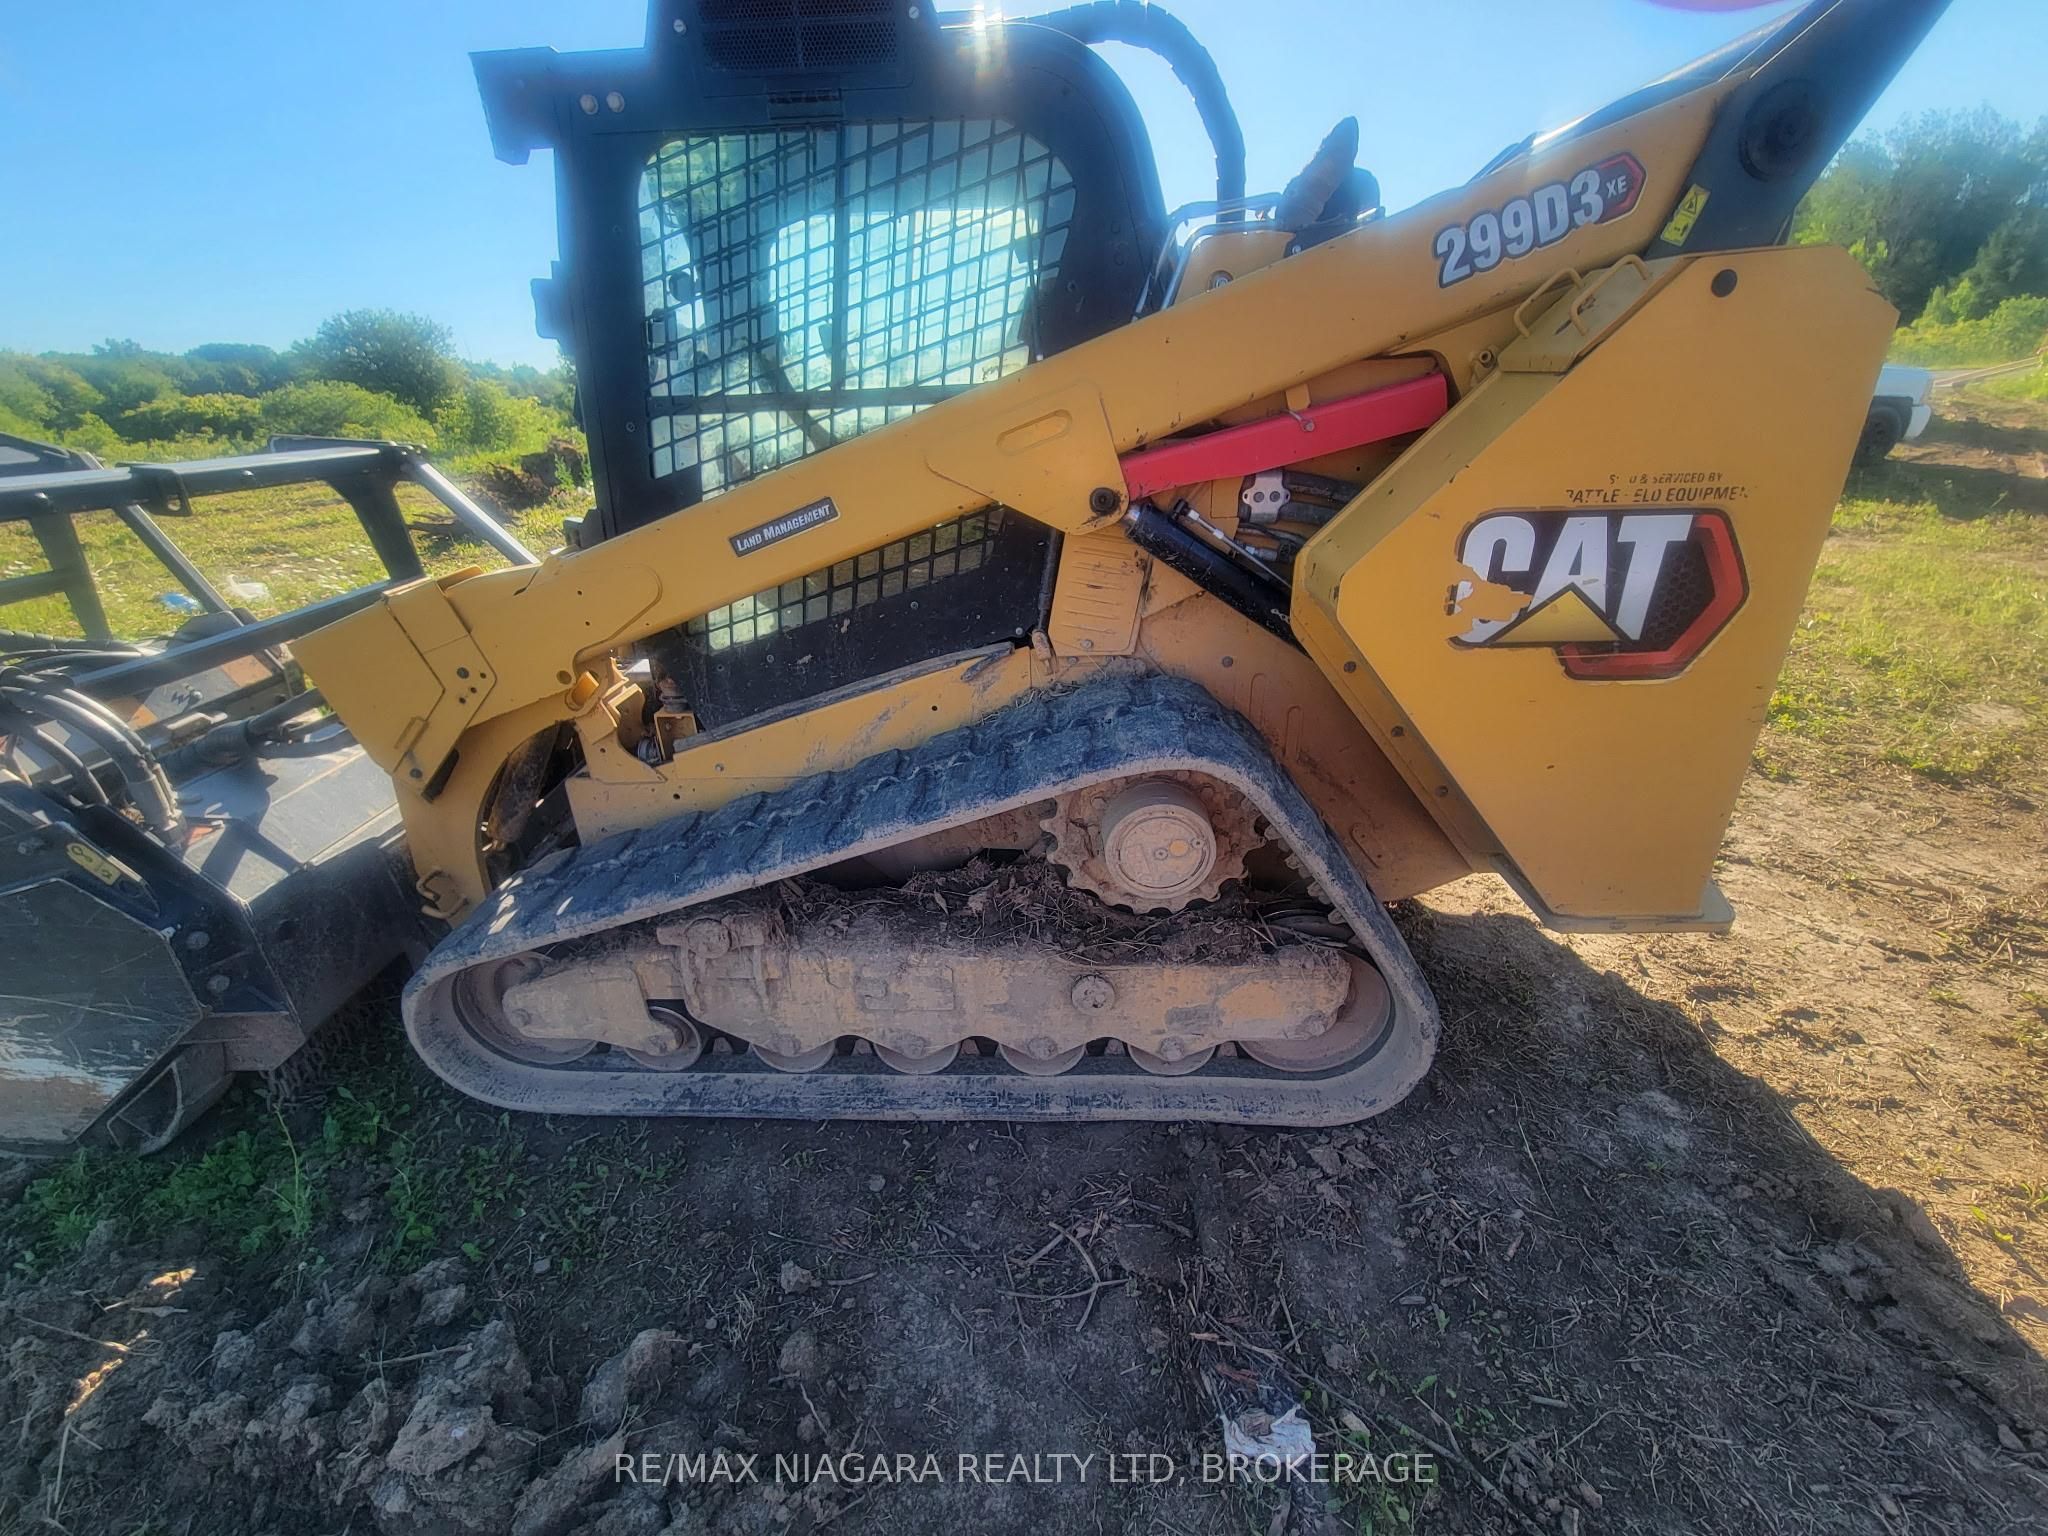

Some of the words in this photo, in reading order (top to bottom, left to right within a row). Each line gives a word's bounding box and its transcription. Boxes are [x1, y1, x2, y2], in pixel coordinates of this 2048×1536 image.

[1436, 169, 1603, 285] 299D3
[1606, 176, 1627, 198] XE
[1640, 473, 1648, 484] &
[1708, 472, 1723, 482] BY
[737, 534, 762, 551] LAND
[763, 504, 831, 540] MANAGEMENT
[1450, 514, 1693, 643] CAT
